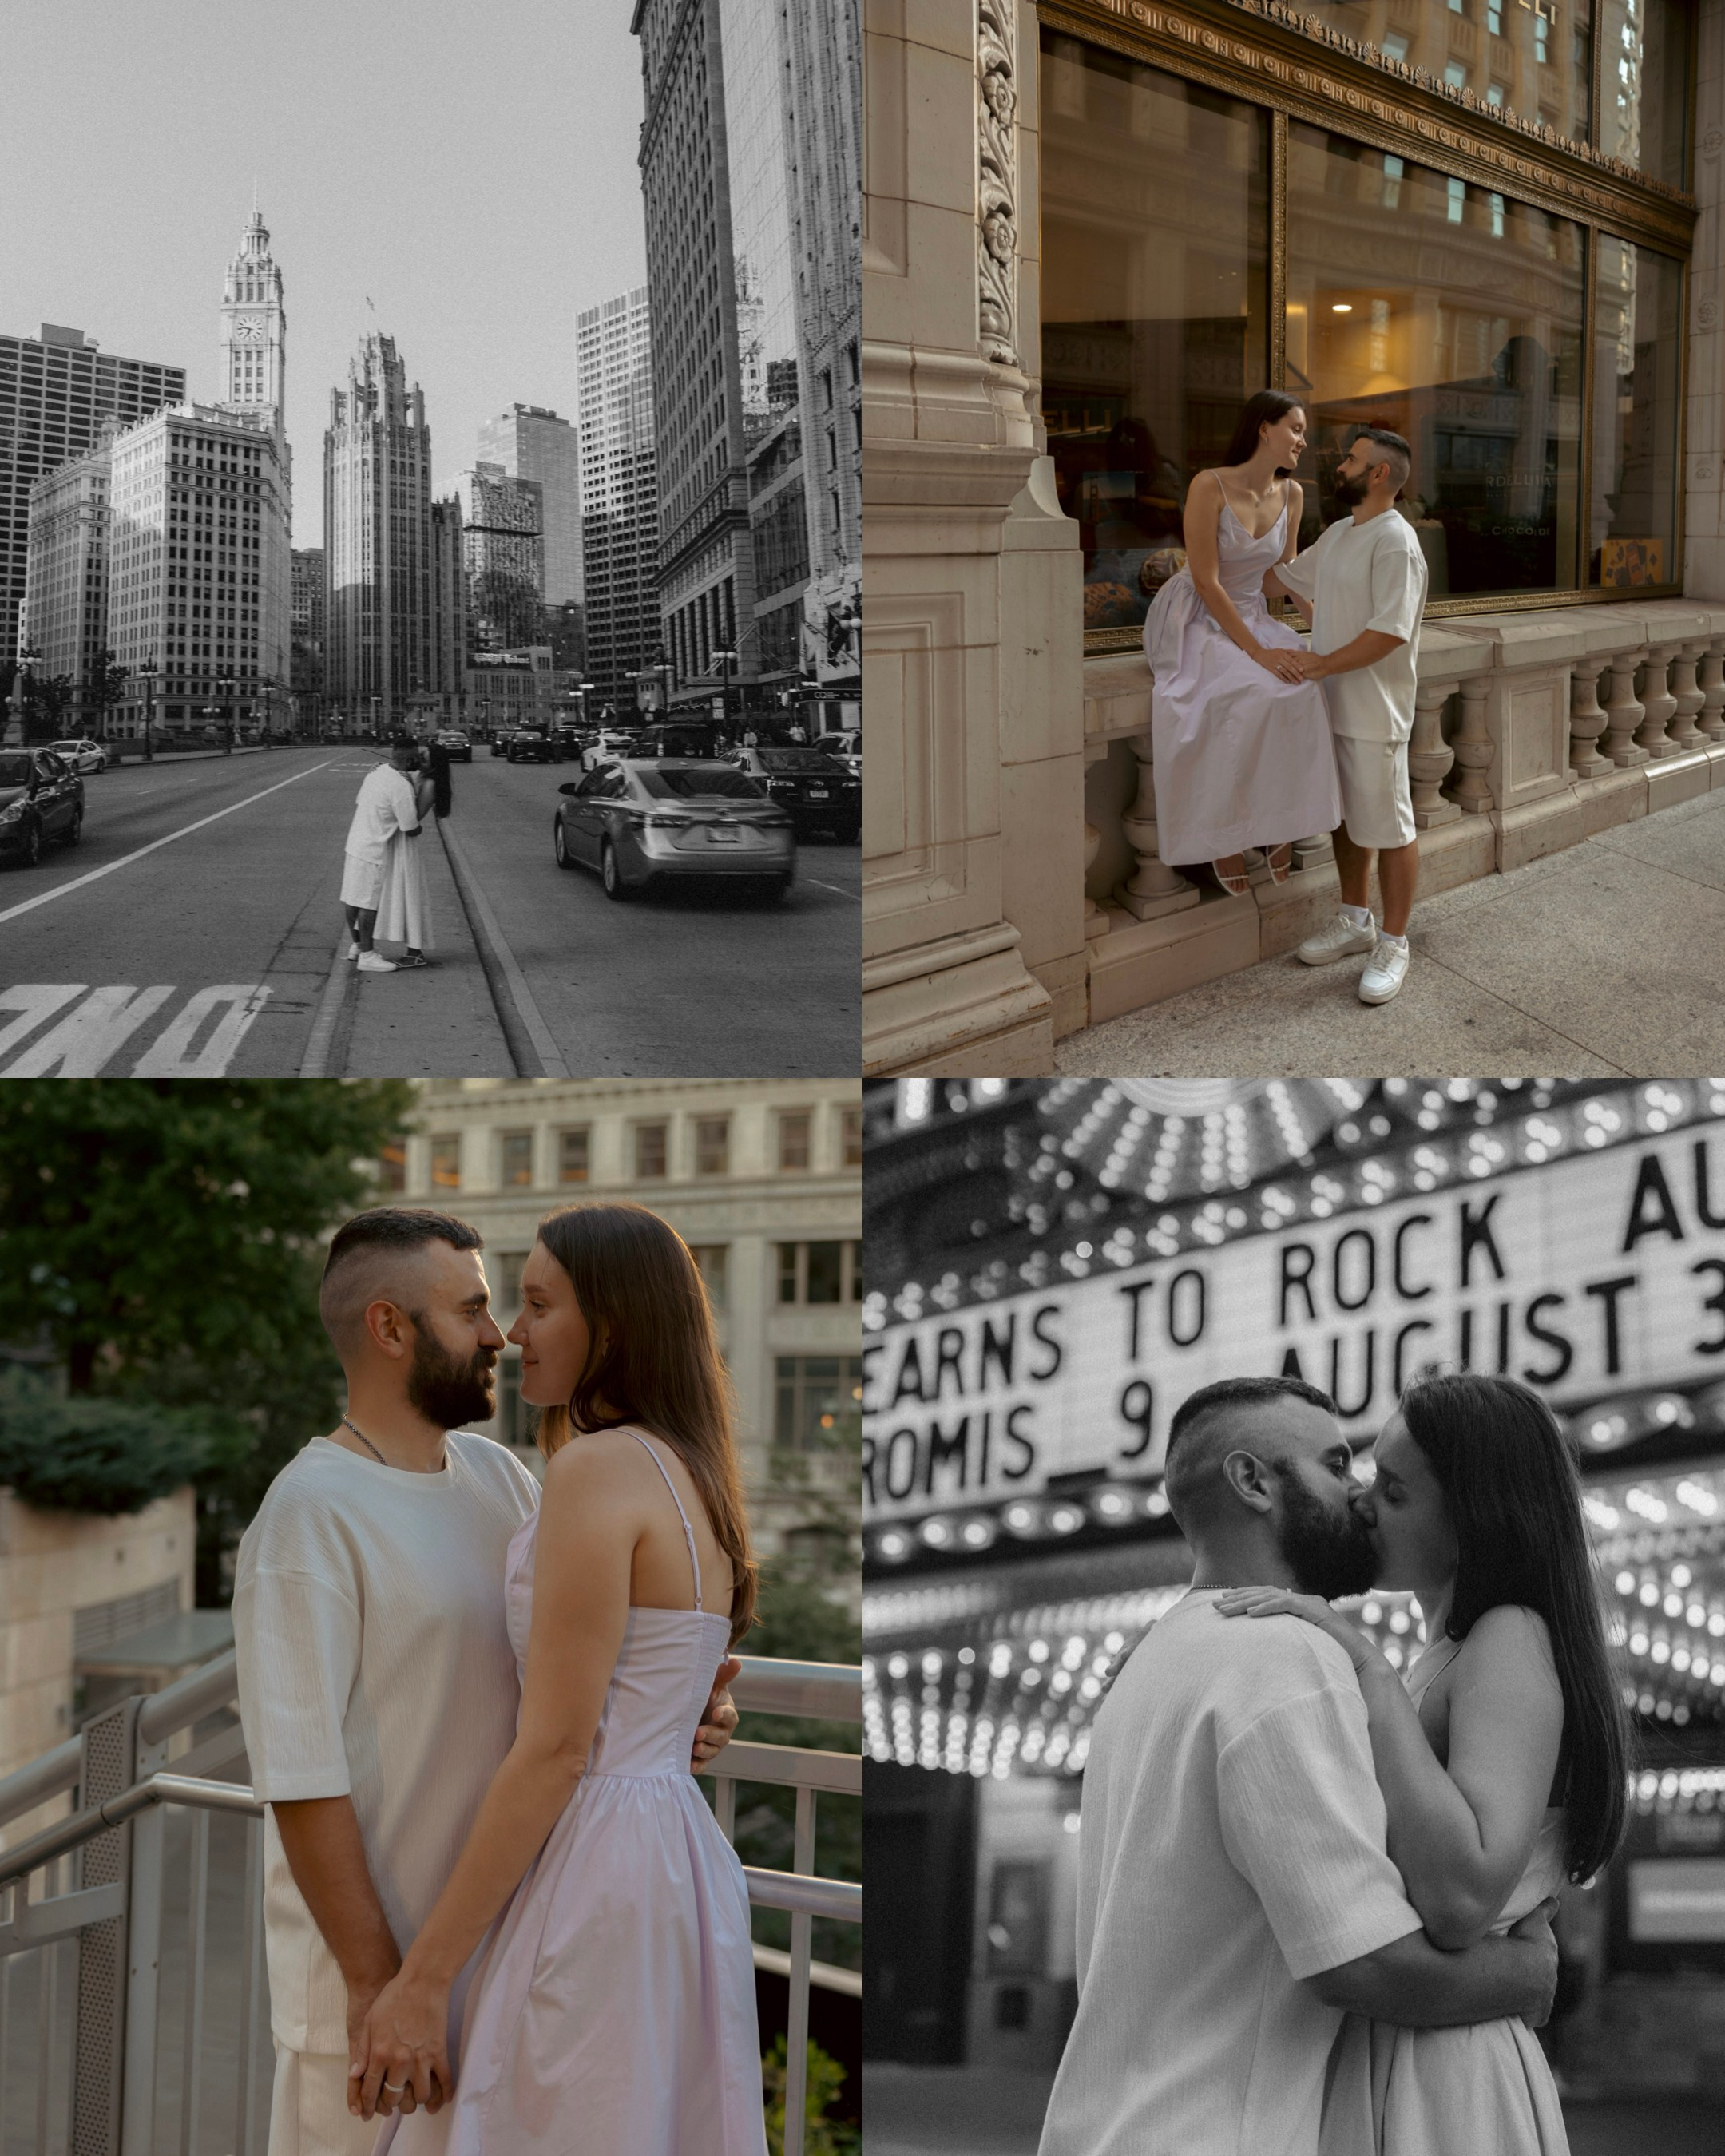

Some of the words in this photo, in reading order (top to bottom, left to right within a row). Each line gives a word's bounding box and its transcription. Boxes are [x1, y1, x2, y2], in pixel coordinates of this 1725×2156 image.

[1120, 1270, 1204, 1360] TO
[1280, 1195, 1505, 1327] ROCK
[1121, 1381, 1152, 1457] 9
